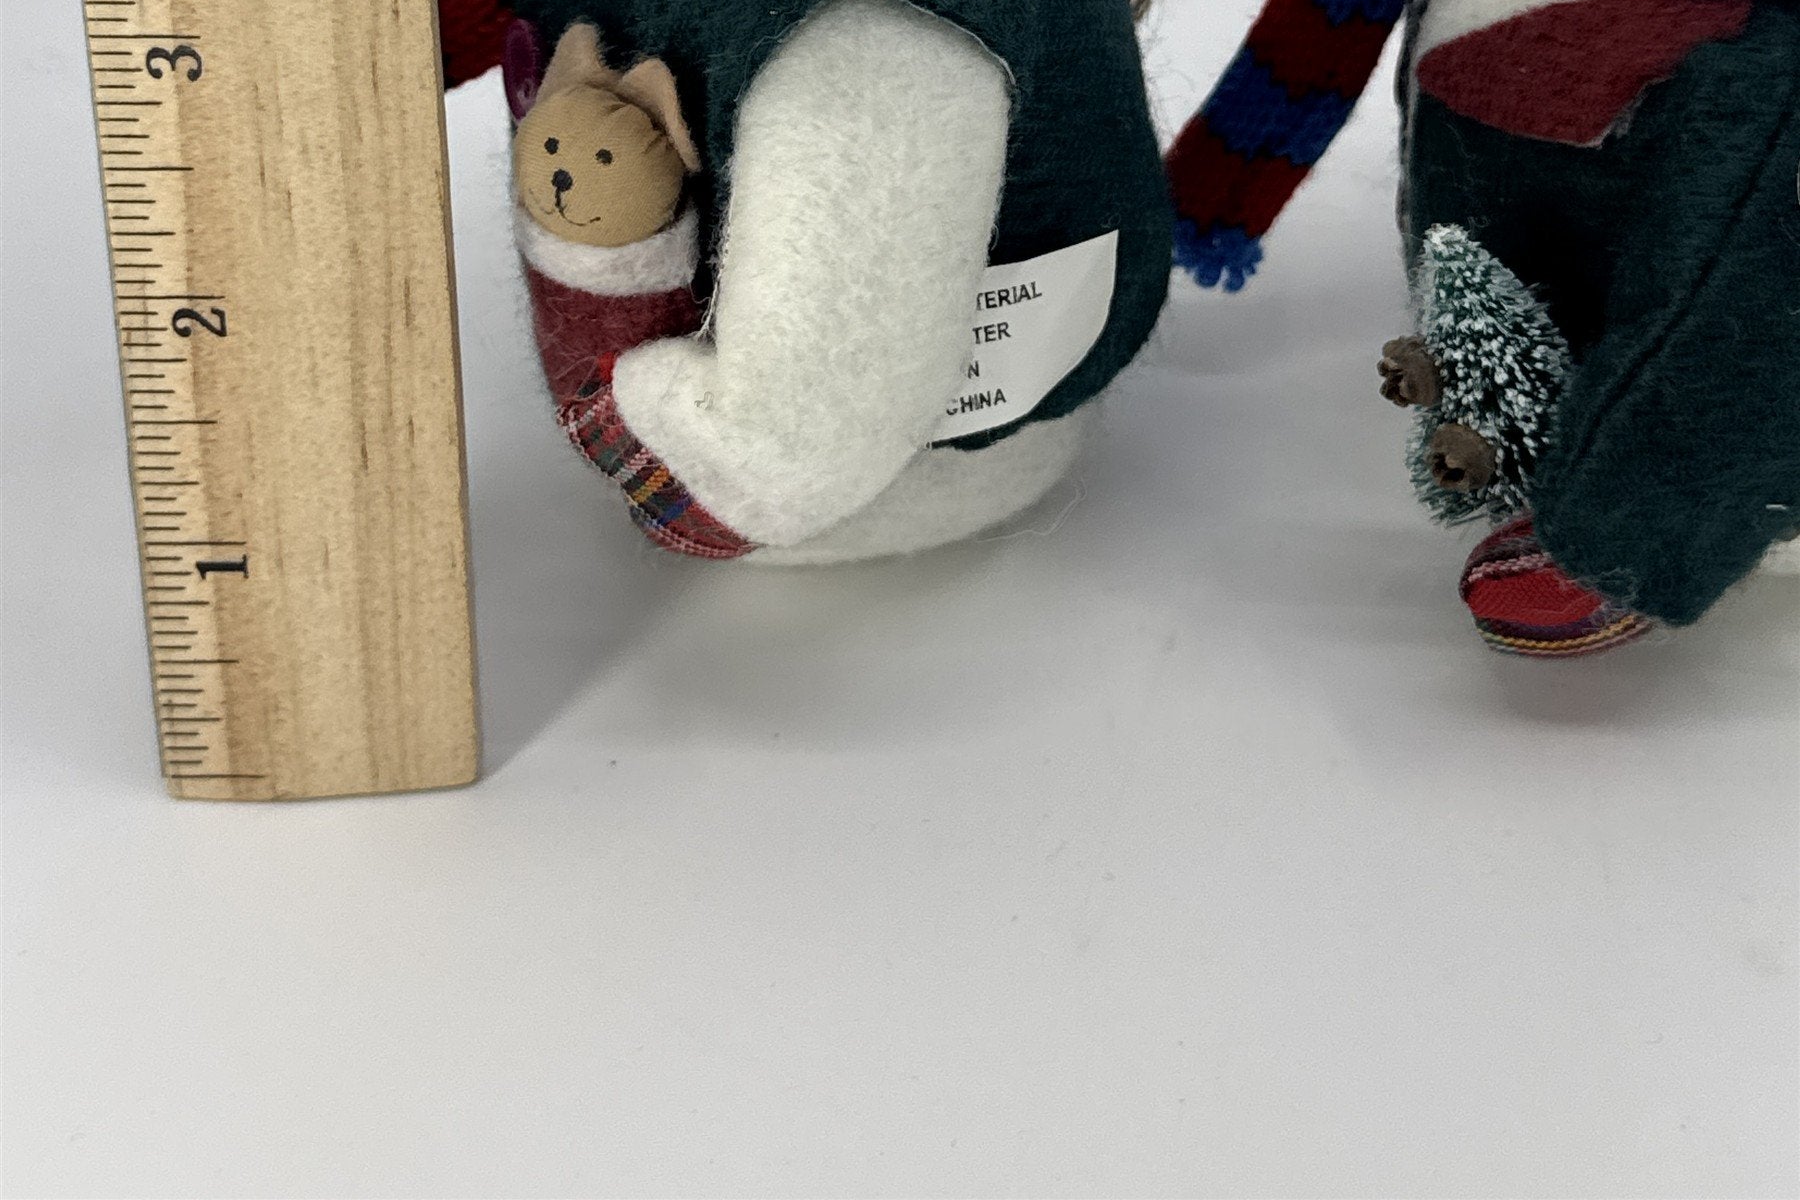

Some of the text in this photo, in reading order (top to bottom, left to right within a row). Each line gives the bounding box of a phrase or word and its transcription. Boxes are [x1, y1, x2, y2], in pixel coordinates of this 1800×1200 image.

[144, 44, 203, 82] 3
[171, 307, 228, 338] 2
[972, 321, 1011, 345] TER
[196, 553, 250, 579] 1
